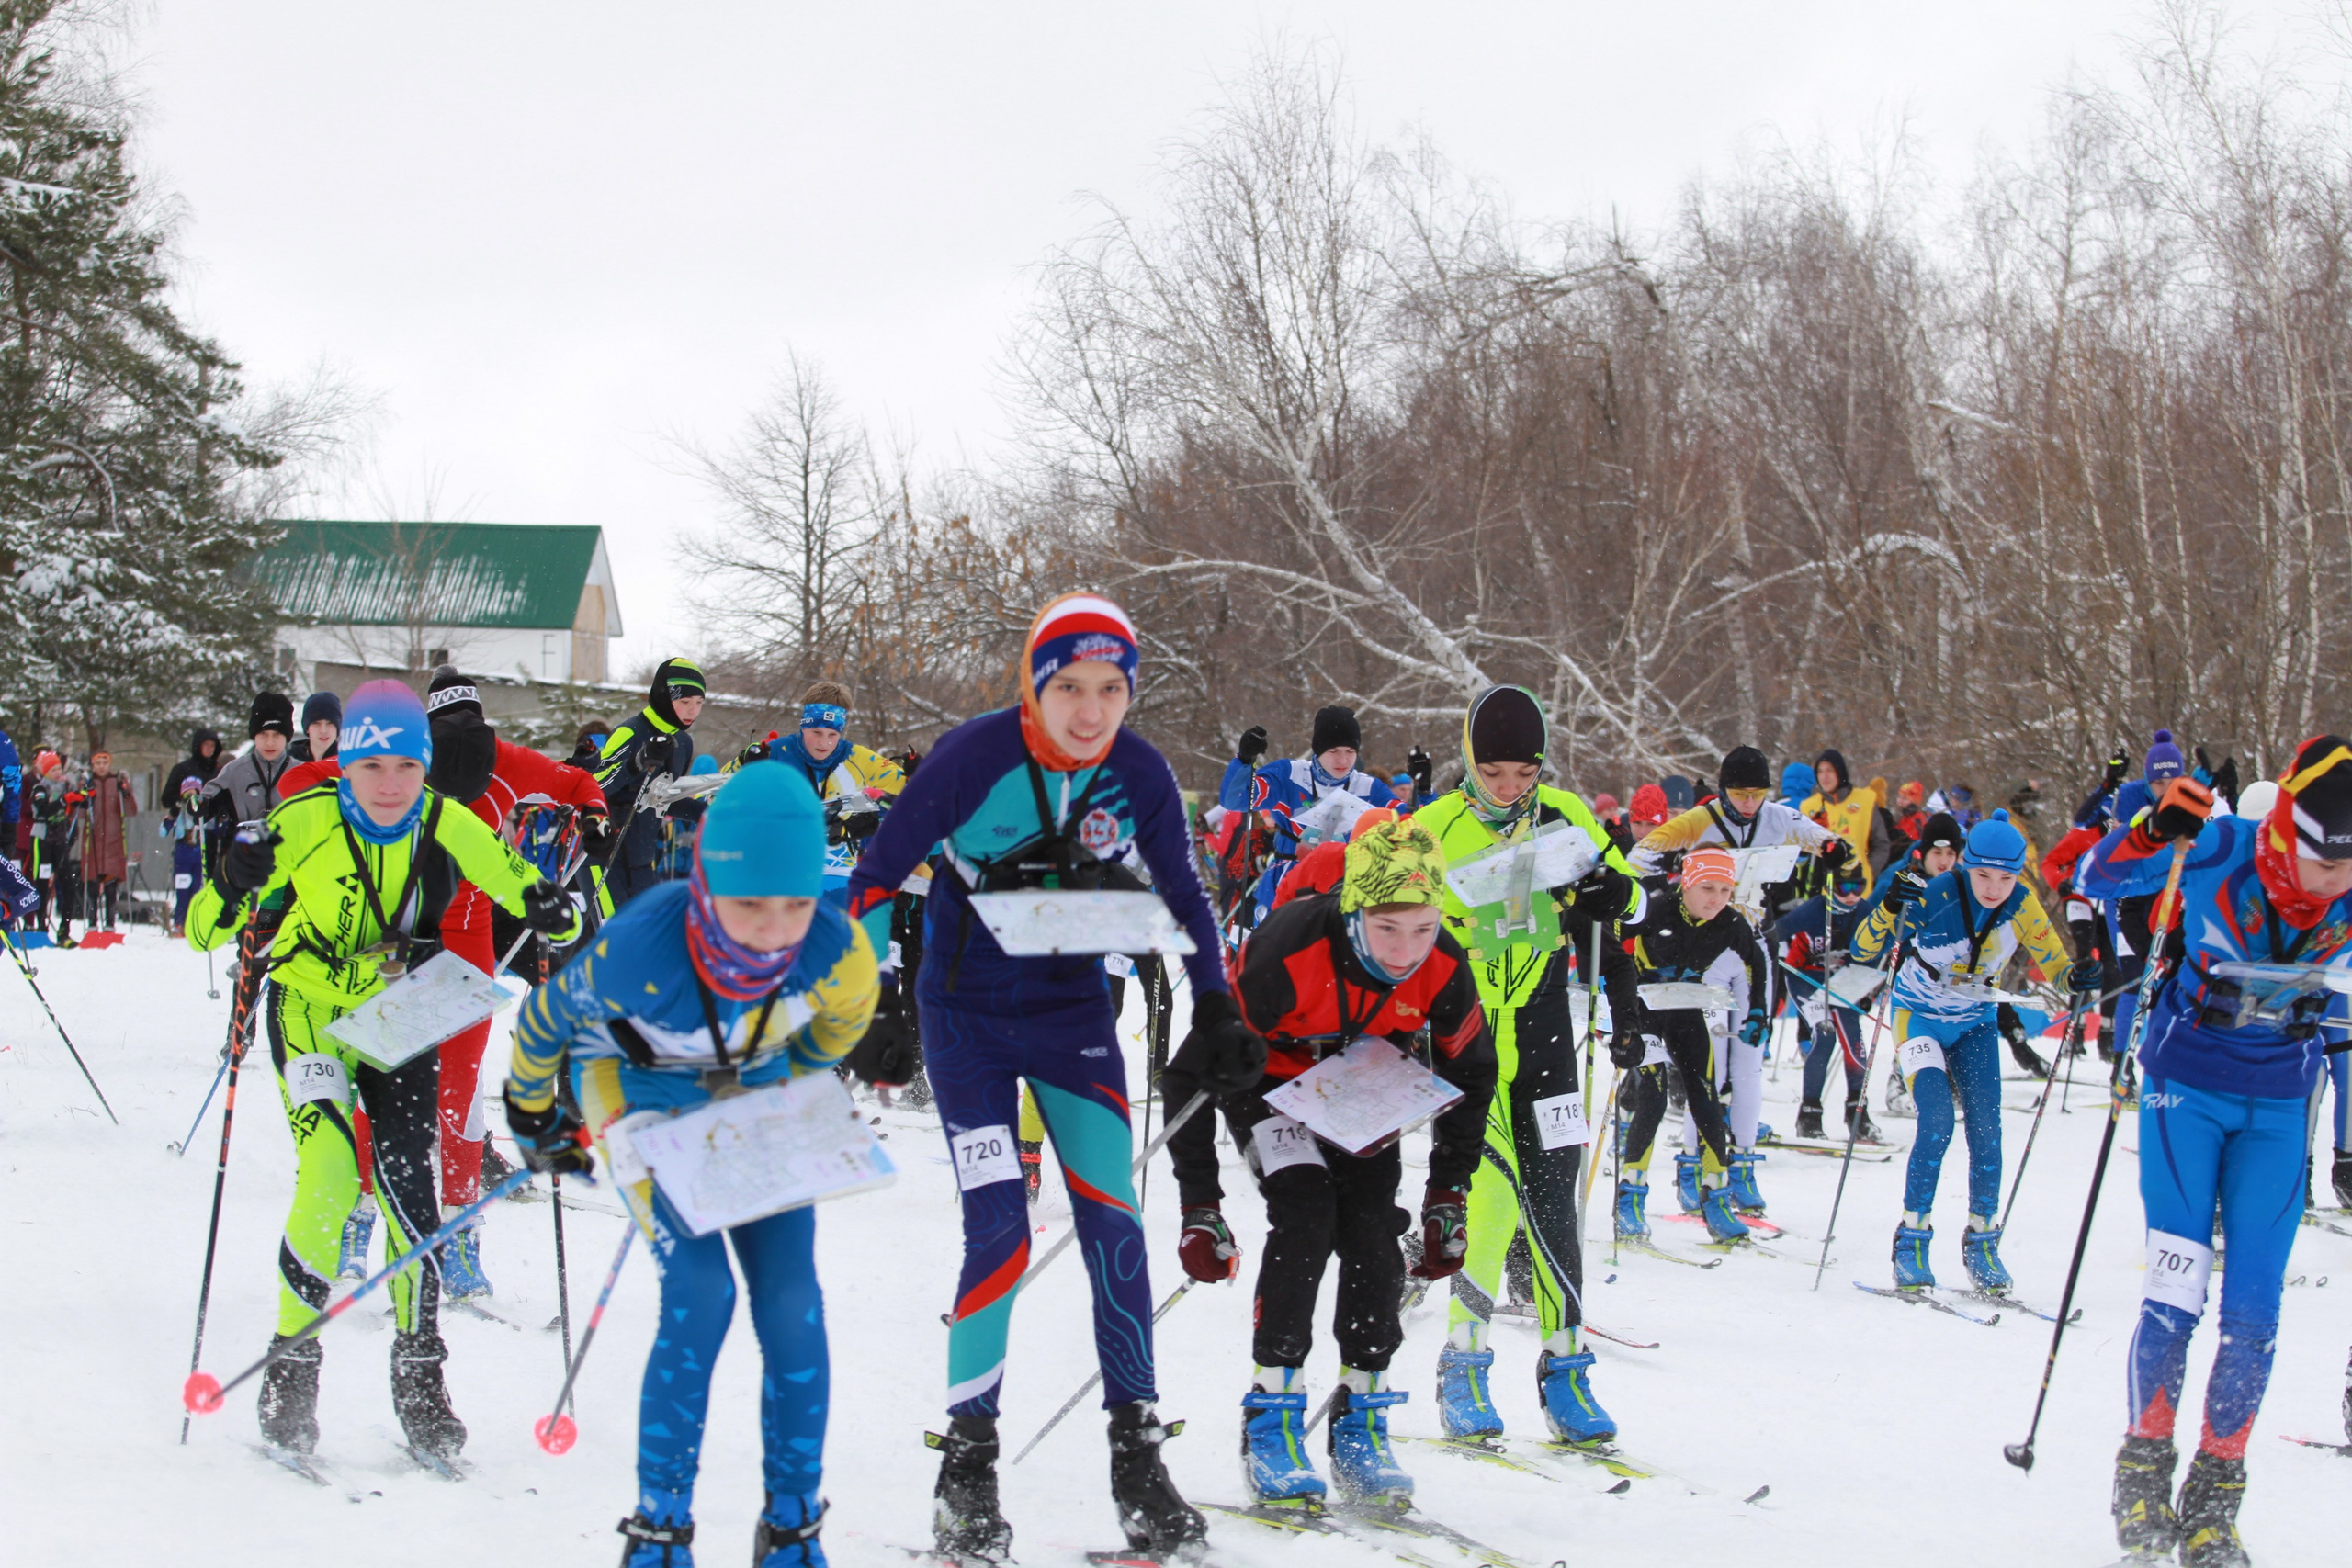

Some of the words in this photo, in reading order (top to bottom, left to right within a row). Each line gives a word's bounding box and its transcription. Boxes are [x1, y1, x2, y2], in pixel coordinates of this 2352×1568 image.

[2153, 761, 2179, 771] RUSSIA
[1908, 1043, 1931, 1056] 735
[300, 1062, 334, 1077] 730
[1552, 1104, 1578, 1122] 718
[1272, 1126, 1306, 1143] 719
[962, 1139, 1001, 1164] 720
[2157, 1249, 2194, 1275] 707
